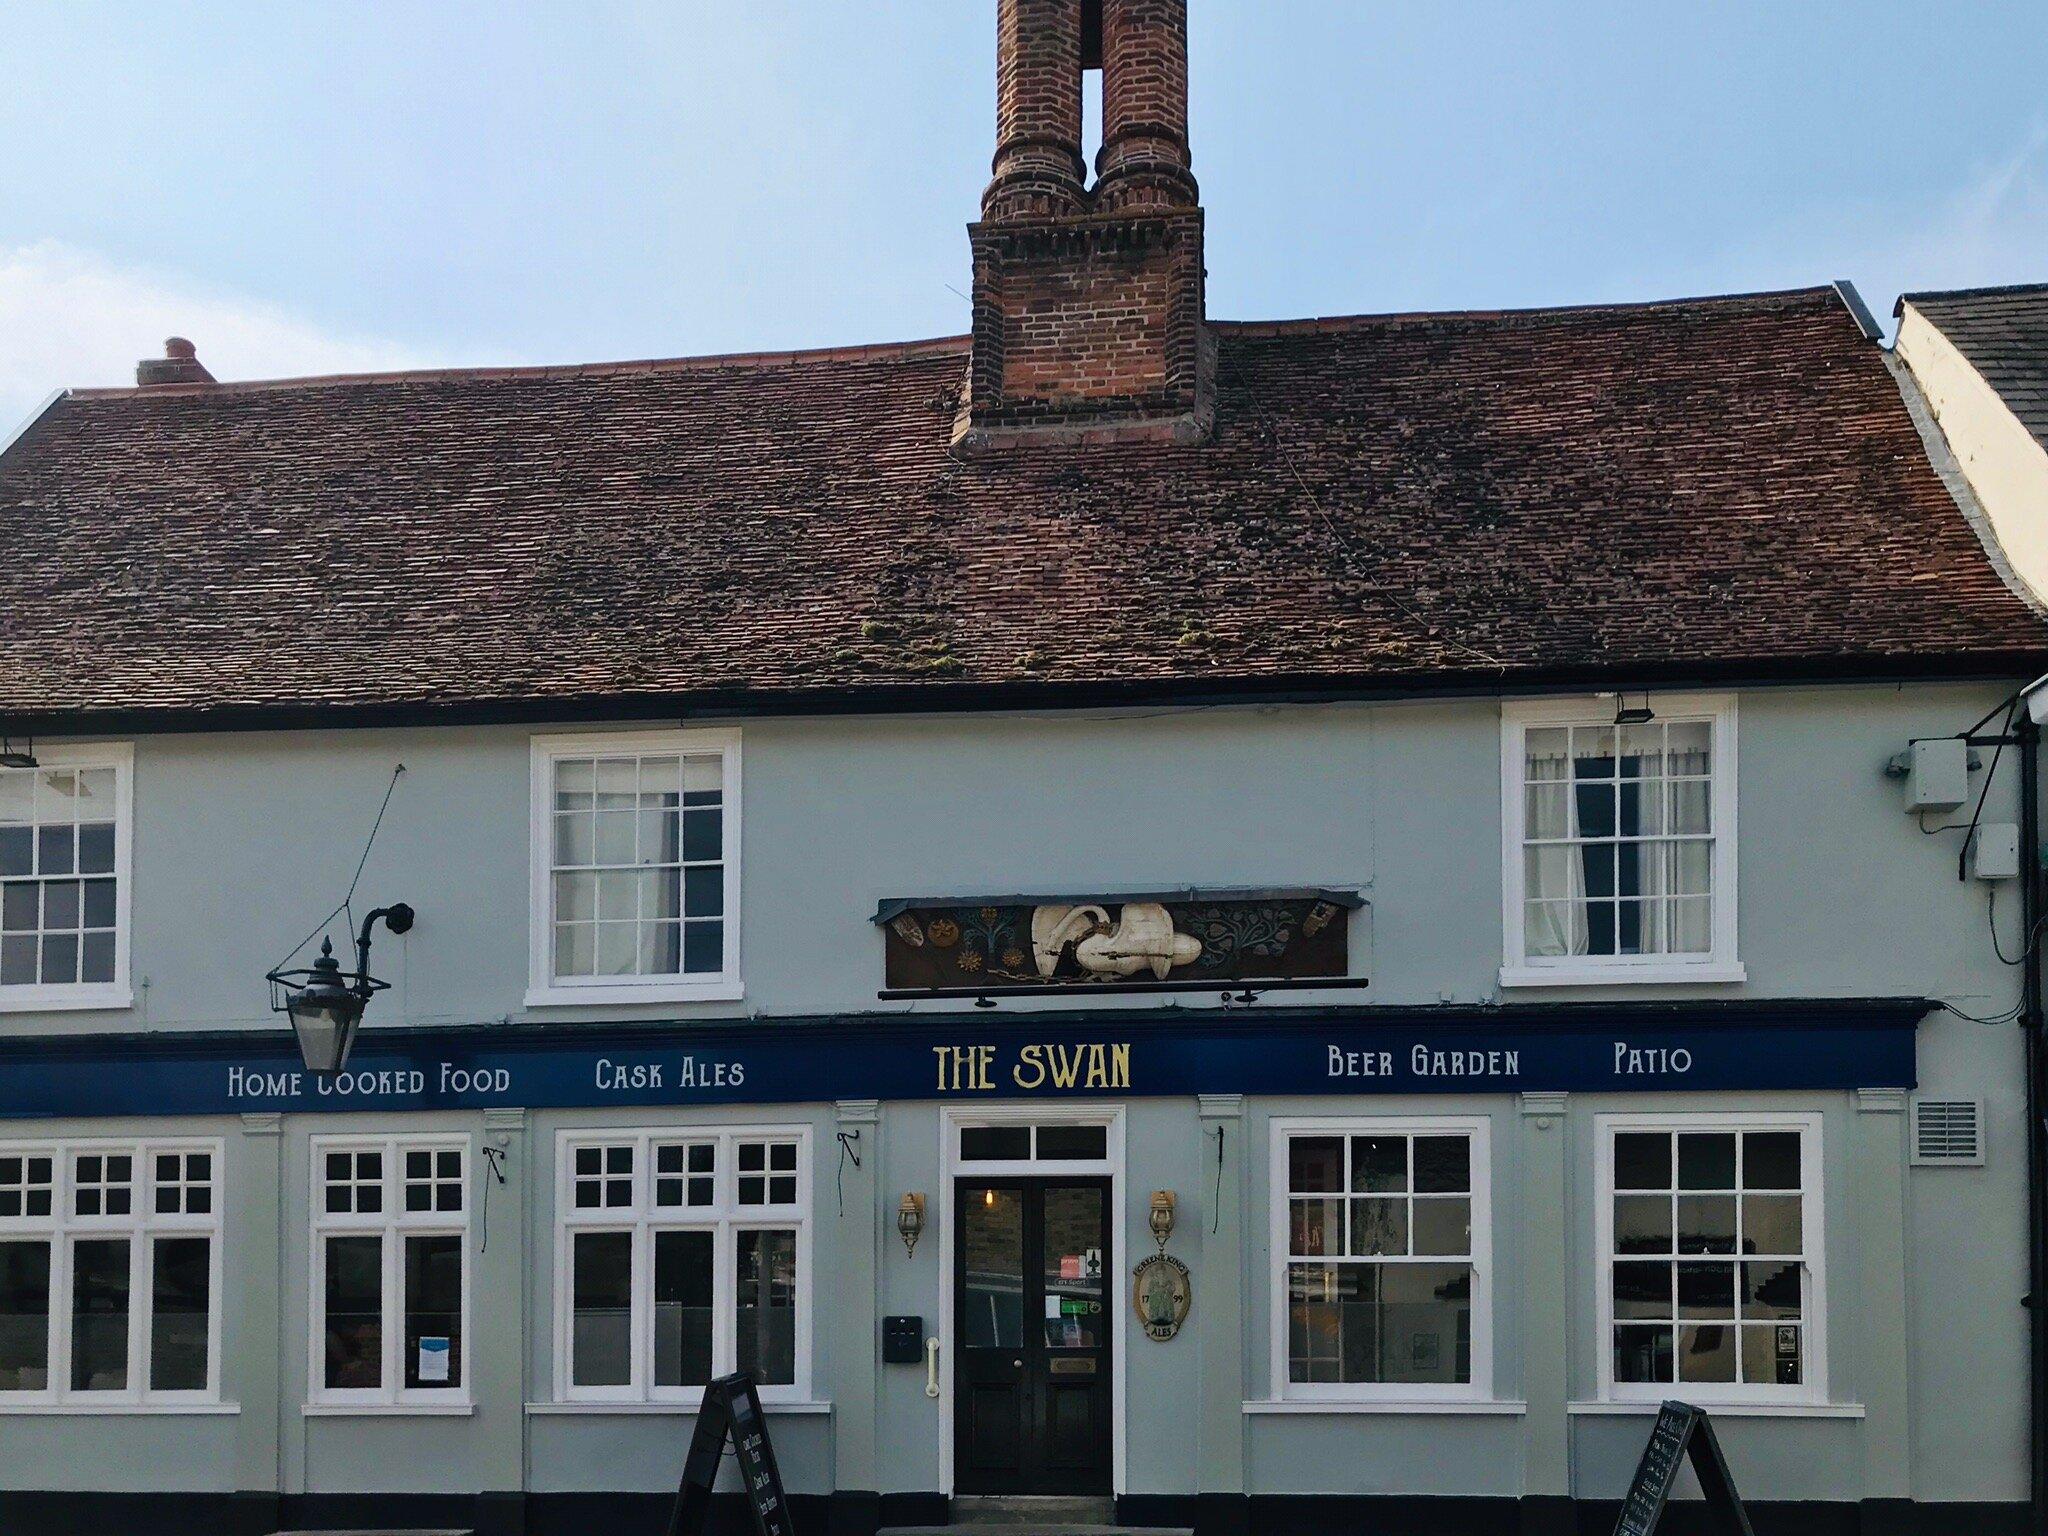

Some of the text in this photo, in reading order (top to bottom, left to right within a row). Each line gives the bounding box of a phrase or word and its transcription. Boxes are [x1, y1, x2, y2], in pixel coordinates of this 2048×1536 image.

[595, 1056, 744, 1090] CASK ALES
[932, 1043, 1131, 1091] THE SWAN
[1327, 1044, 1519, 1077] BEER GARDEN
[1614, 1042, 1692, 1074] PATIO
[228, 1065, 302, 1097] HOME
[440, 1062, 510, 1094] FOOD
[1137, 1254, 1165, 1272] GREENE
[1151, 1328, 1172, 1336] ALES
